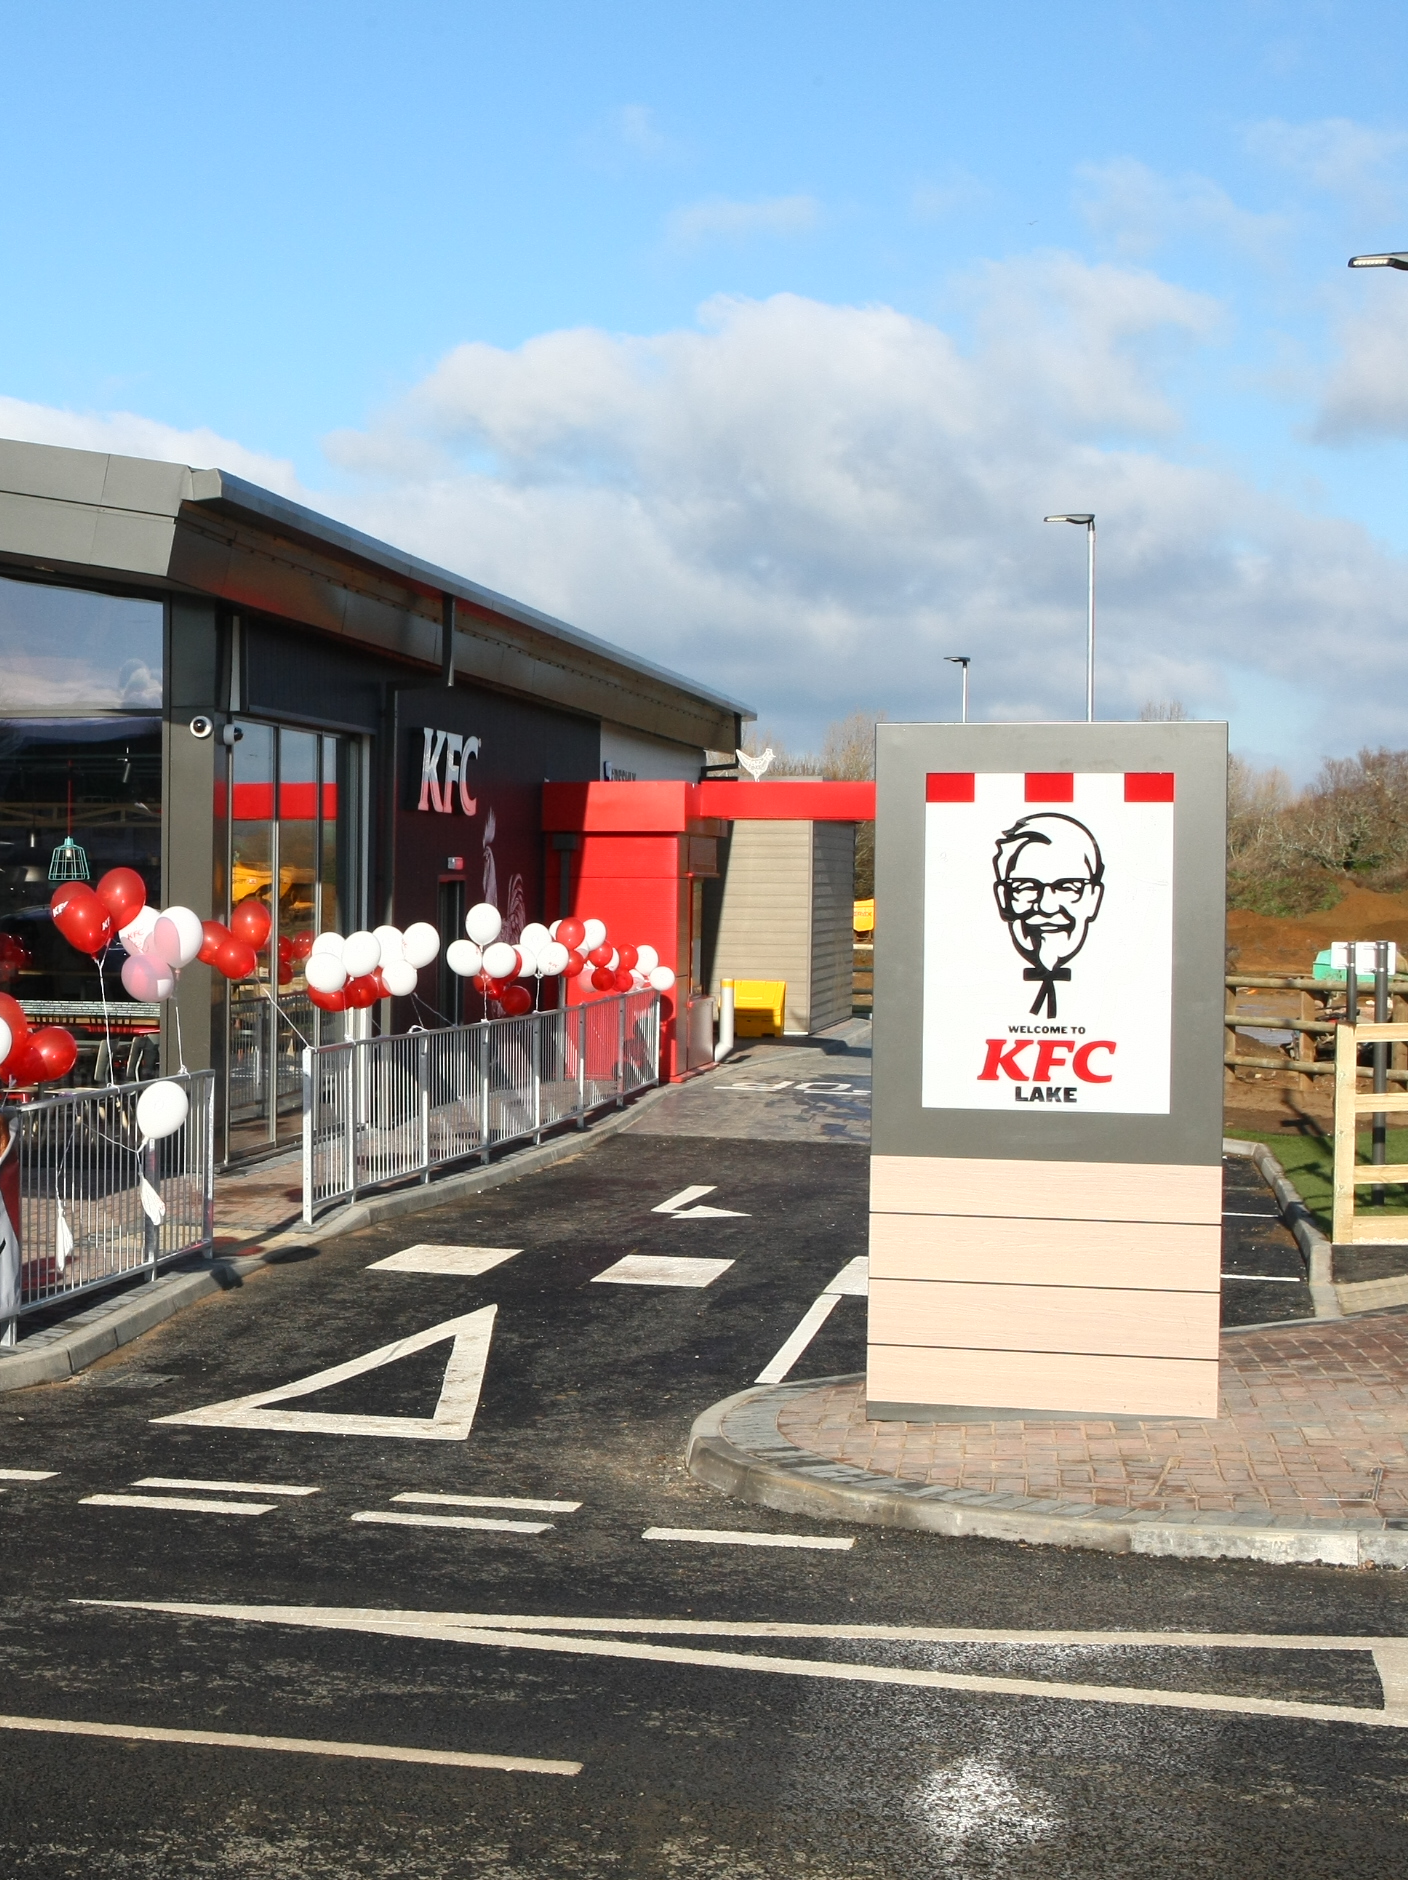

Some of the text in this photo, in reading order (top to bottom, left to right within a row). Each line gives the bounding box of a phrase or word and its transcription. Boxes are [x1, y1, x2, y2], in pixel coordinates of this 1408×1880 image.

[418, 727, 479, 817] KFC
[1008, 1025, 1086, 1035] WELCOME TO
[977, 1039, 1117, 1083] KFC
[1015, 1086, 1078, 1103] LAKE
